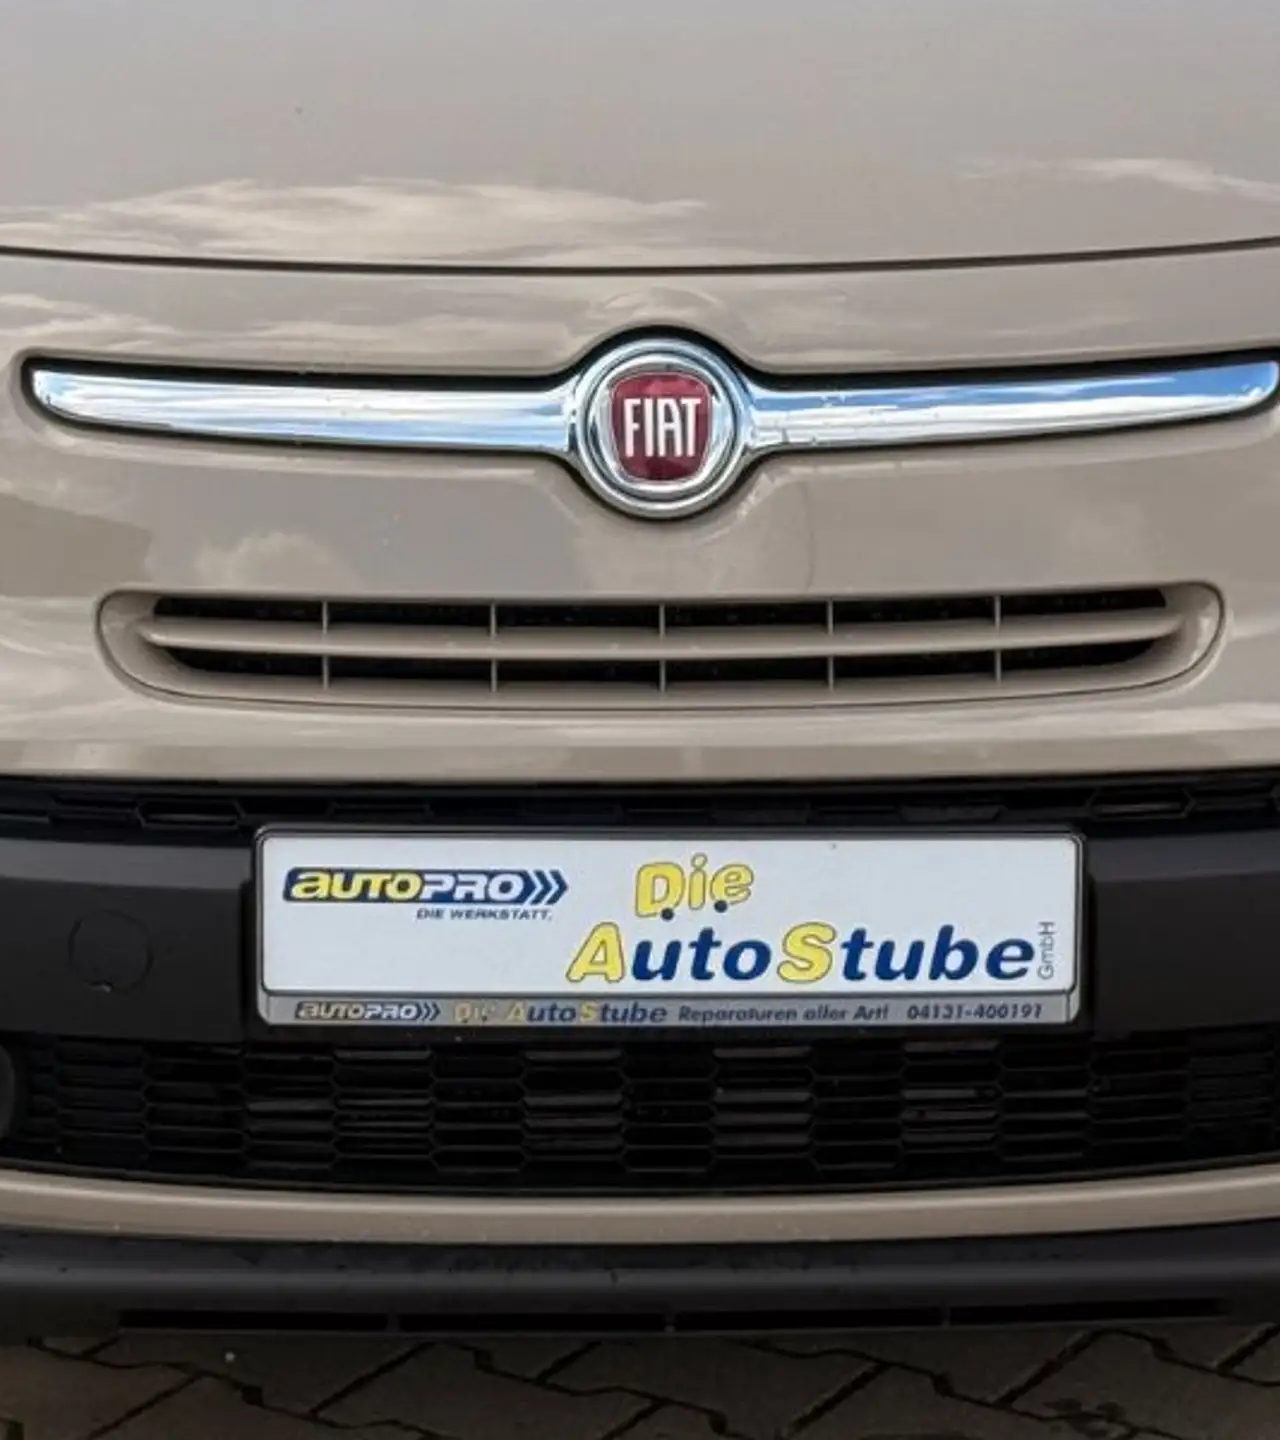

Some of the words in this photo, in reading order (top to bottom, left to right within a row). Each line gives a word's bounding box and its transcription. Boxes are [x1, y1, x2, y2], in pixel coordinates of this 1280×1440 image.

[623, 397, 702, 458] FIAT
[416, 908, 445, 921] DIE
[634, 851, 755, 919] Die
[1037, 921, 1055, 981] GmbH
[677, 1004, 798, 1023] Reparaturen
[803, 1004, 847, 1021] aller
